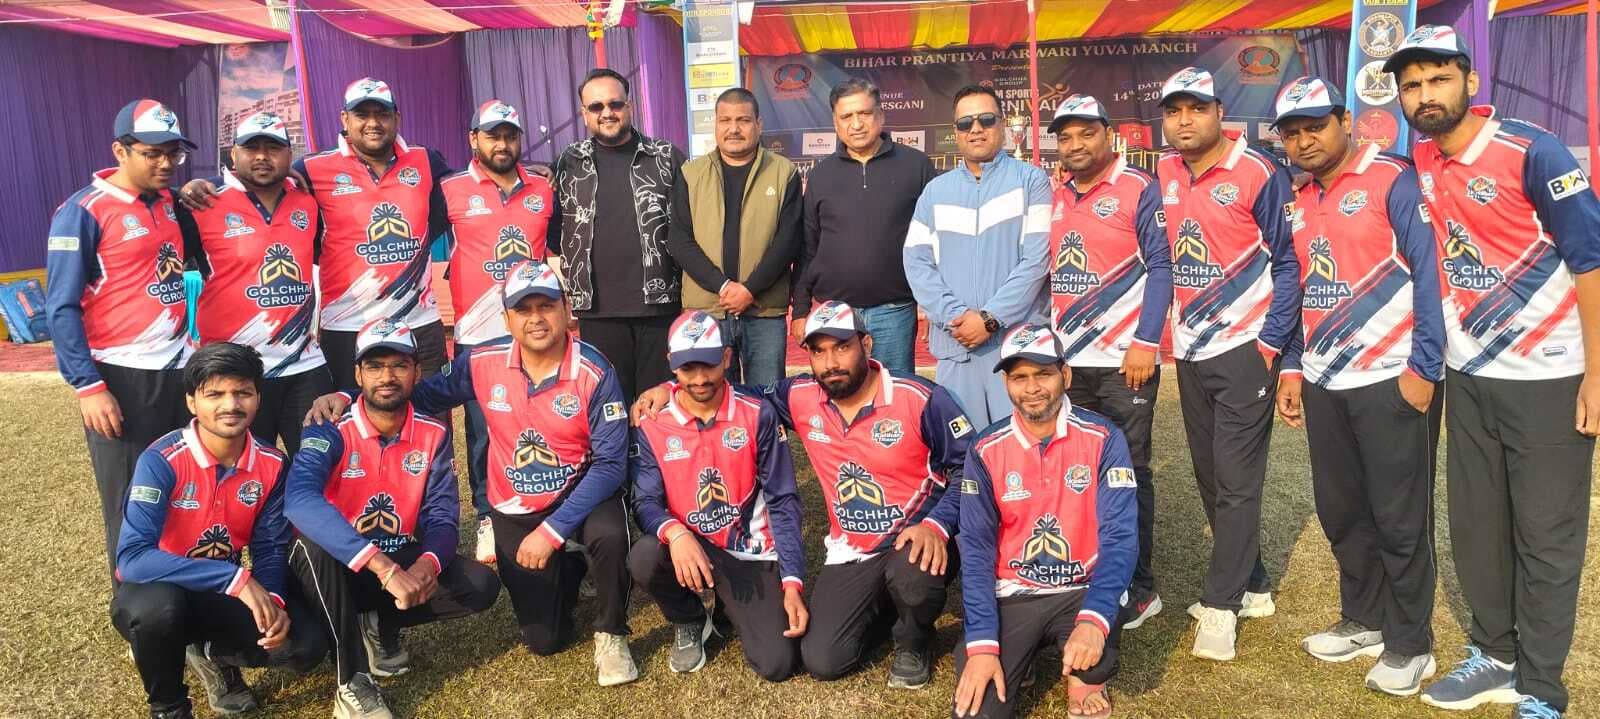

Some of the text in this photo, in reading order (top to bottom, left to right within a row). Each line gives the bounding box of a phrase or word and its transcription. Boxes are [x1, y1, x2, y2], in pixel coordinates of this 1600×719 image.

[844, 42, 1197, 68] BIHAR PRANTIYA MARWARI YUVA MANCH
[880, 99, 924, 110] ESGANJ
[358, 239, 419, 254] GOLCHHA
[368, 249, 415, 262] GROUP
[485, 261, 512, 271] GOL
[248, 282, 310, 296] GOLCHHA
[260, 293, 305, 305] GROUP
[506, 466, 573, 482] GOLCHHA
[514, 479, 565, 493] GROUP
[689, 505, 740, 522] GOLCHHA
[700, 514, 733, 532] GROUP
[840, 519, 891, 531] GROUP
[370, 536, 407, 546] CHHA
